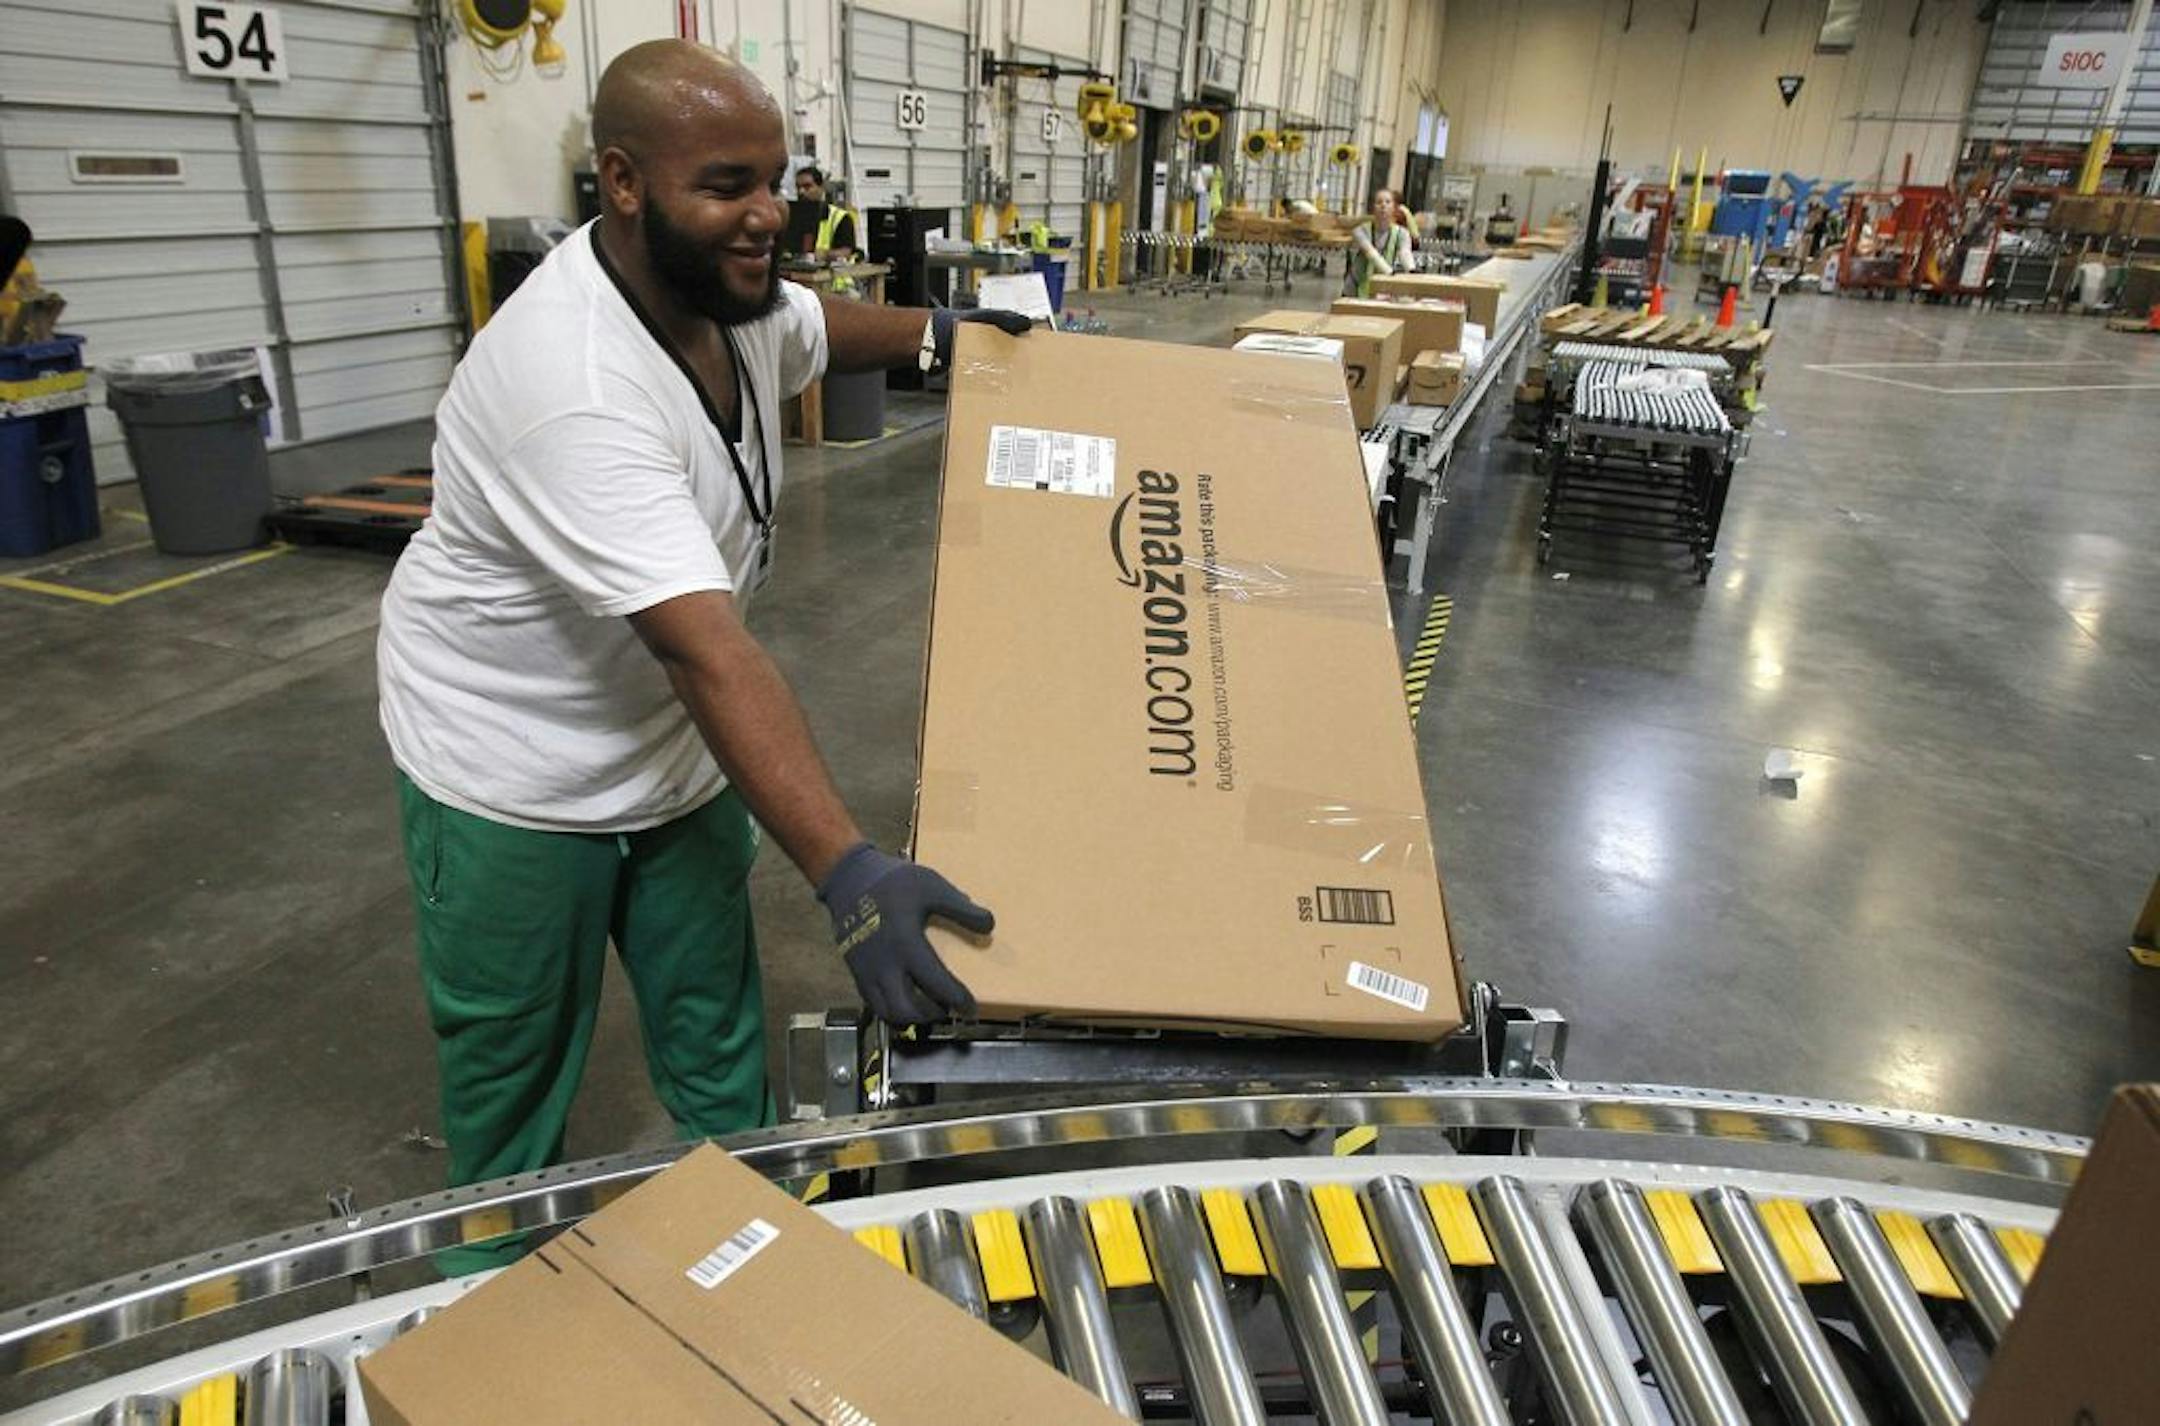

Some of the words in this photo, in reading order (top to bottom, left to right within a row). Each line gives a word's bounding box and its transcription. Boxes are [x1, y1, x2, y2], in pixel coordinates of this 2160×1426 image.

[196, 7, 276, 72] 54
[2059, 51, 2106, 71] SIOC
[902, 95, 925, 124] 56
[1045, 113, 1061, 136] 57
[1198, 474, 1213, 501] Rate
[1199, 502, 1216, 527] this
[1137, 470, 1197, 776] amazon.com
